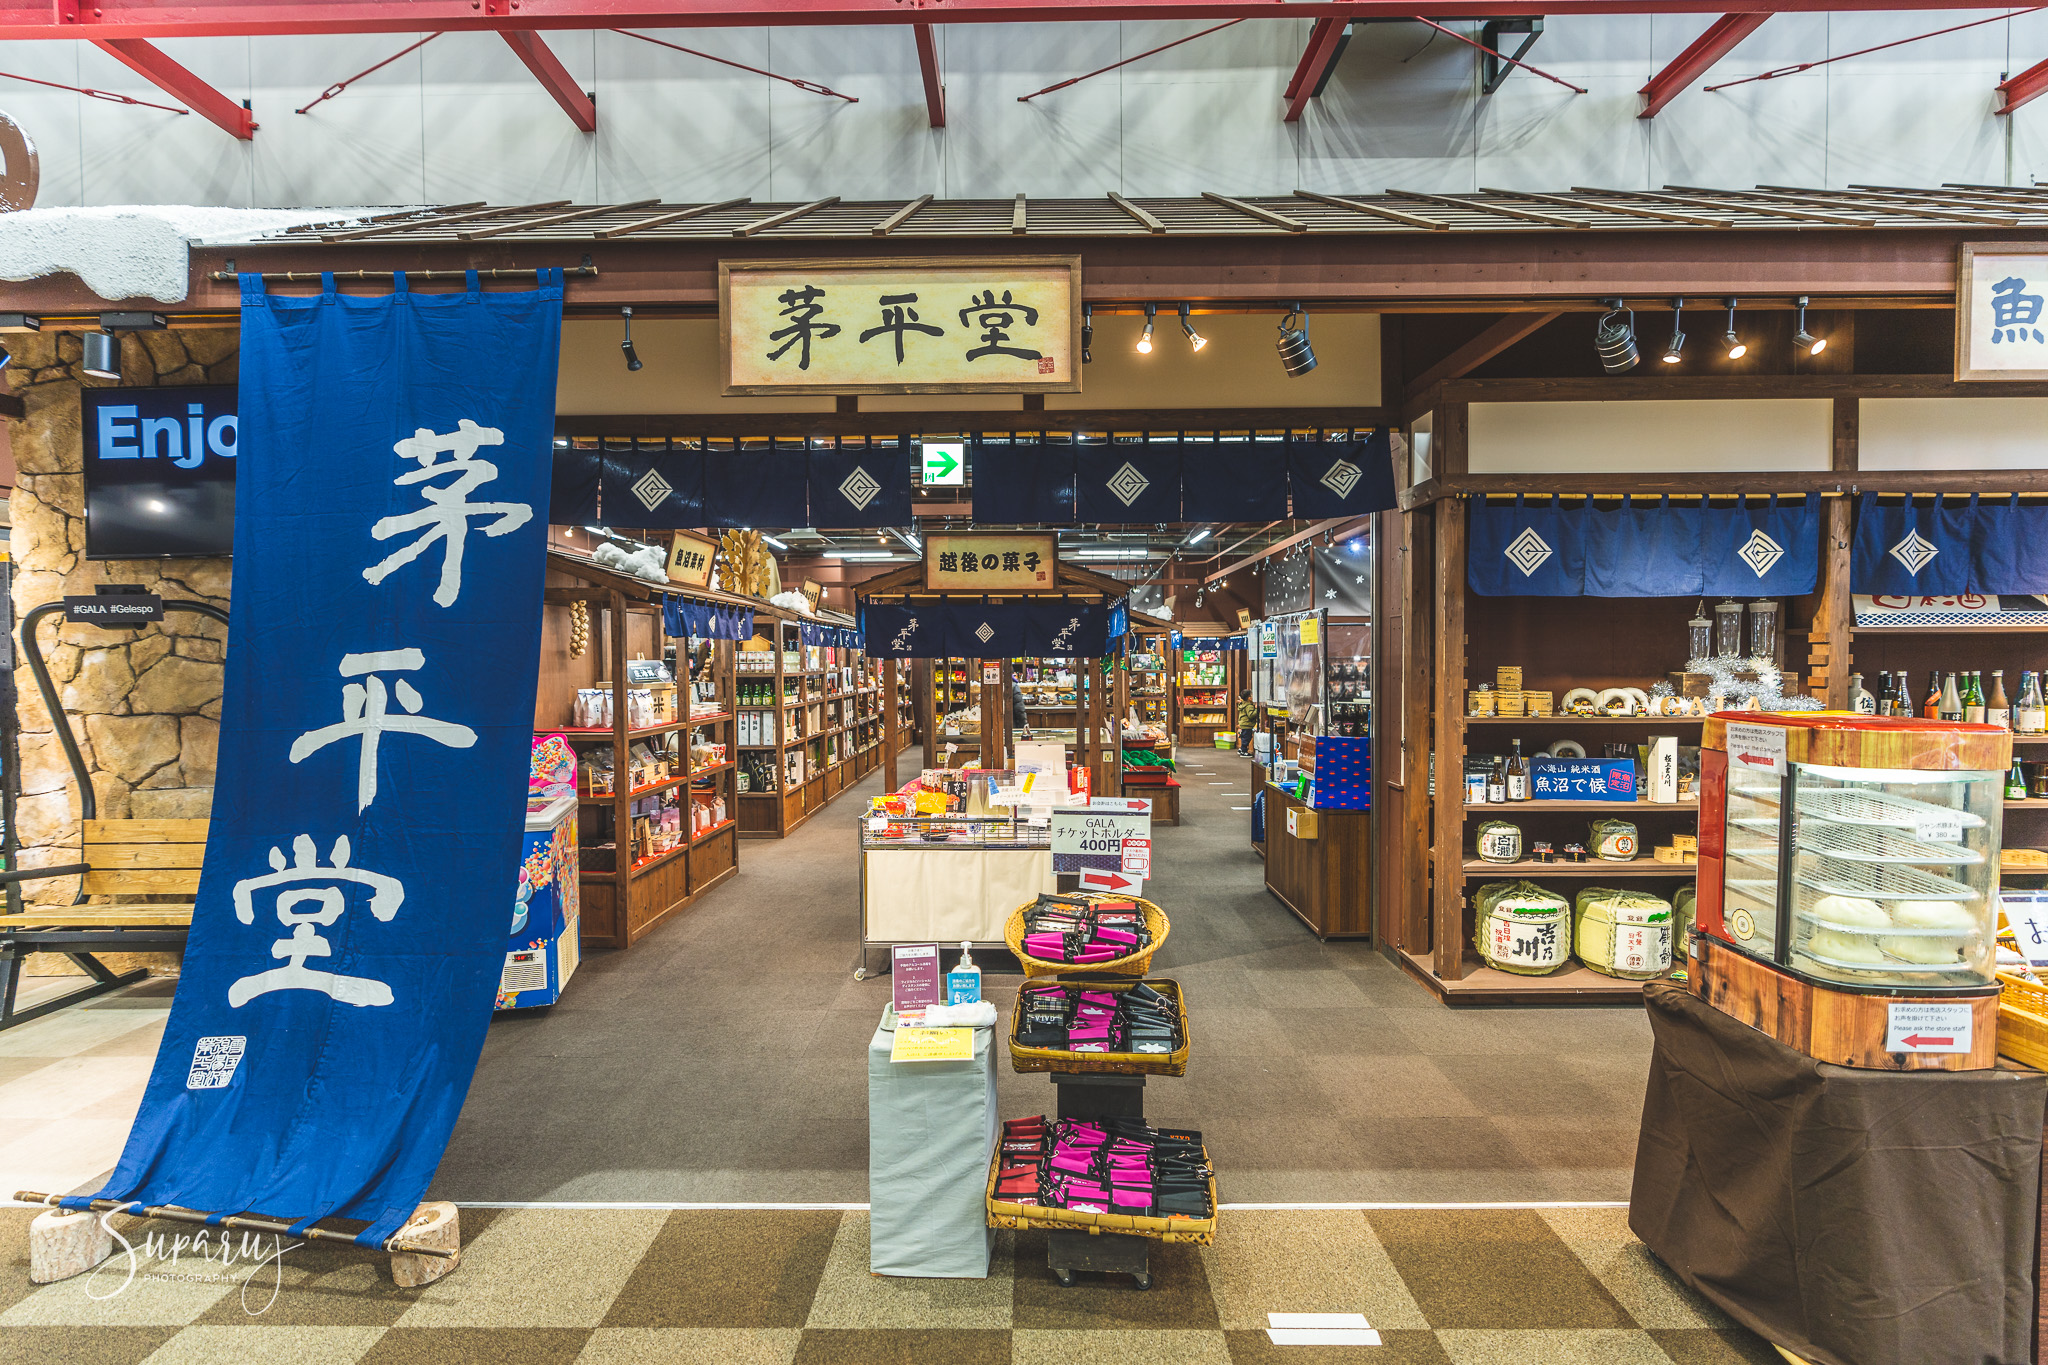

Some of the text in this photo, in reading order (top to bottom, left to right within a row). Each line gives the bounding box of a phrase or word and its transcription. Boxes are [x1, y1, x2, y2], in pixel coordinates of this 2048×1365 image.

[1991, 276, 2045, 344] 魚
[767, 284, 1042, 371] 茅平堂
[675, 548, 705, 572] 魚沼素材
[938, 551, 1041, 573] 越後の菓子
[73, 604, 153, 615] #GALA #Gelespo
[891, 617, 920, 651] 茅平堂
[1051, 617, 1081, 651] 茅平堂
[228, 418, 533, 1010] 茅平堂
[1537, 764, 1601, 774] 八海山 純米酒
[1536, 776, 1608, 794] 魚沼で候
[1056, 827, 1145, 839] チケットホルダー
[1085, 818, 1115, 828] GALA
[1080, 840, 1120, 852] 400円
